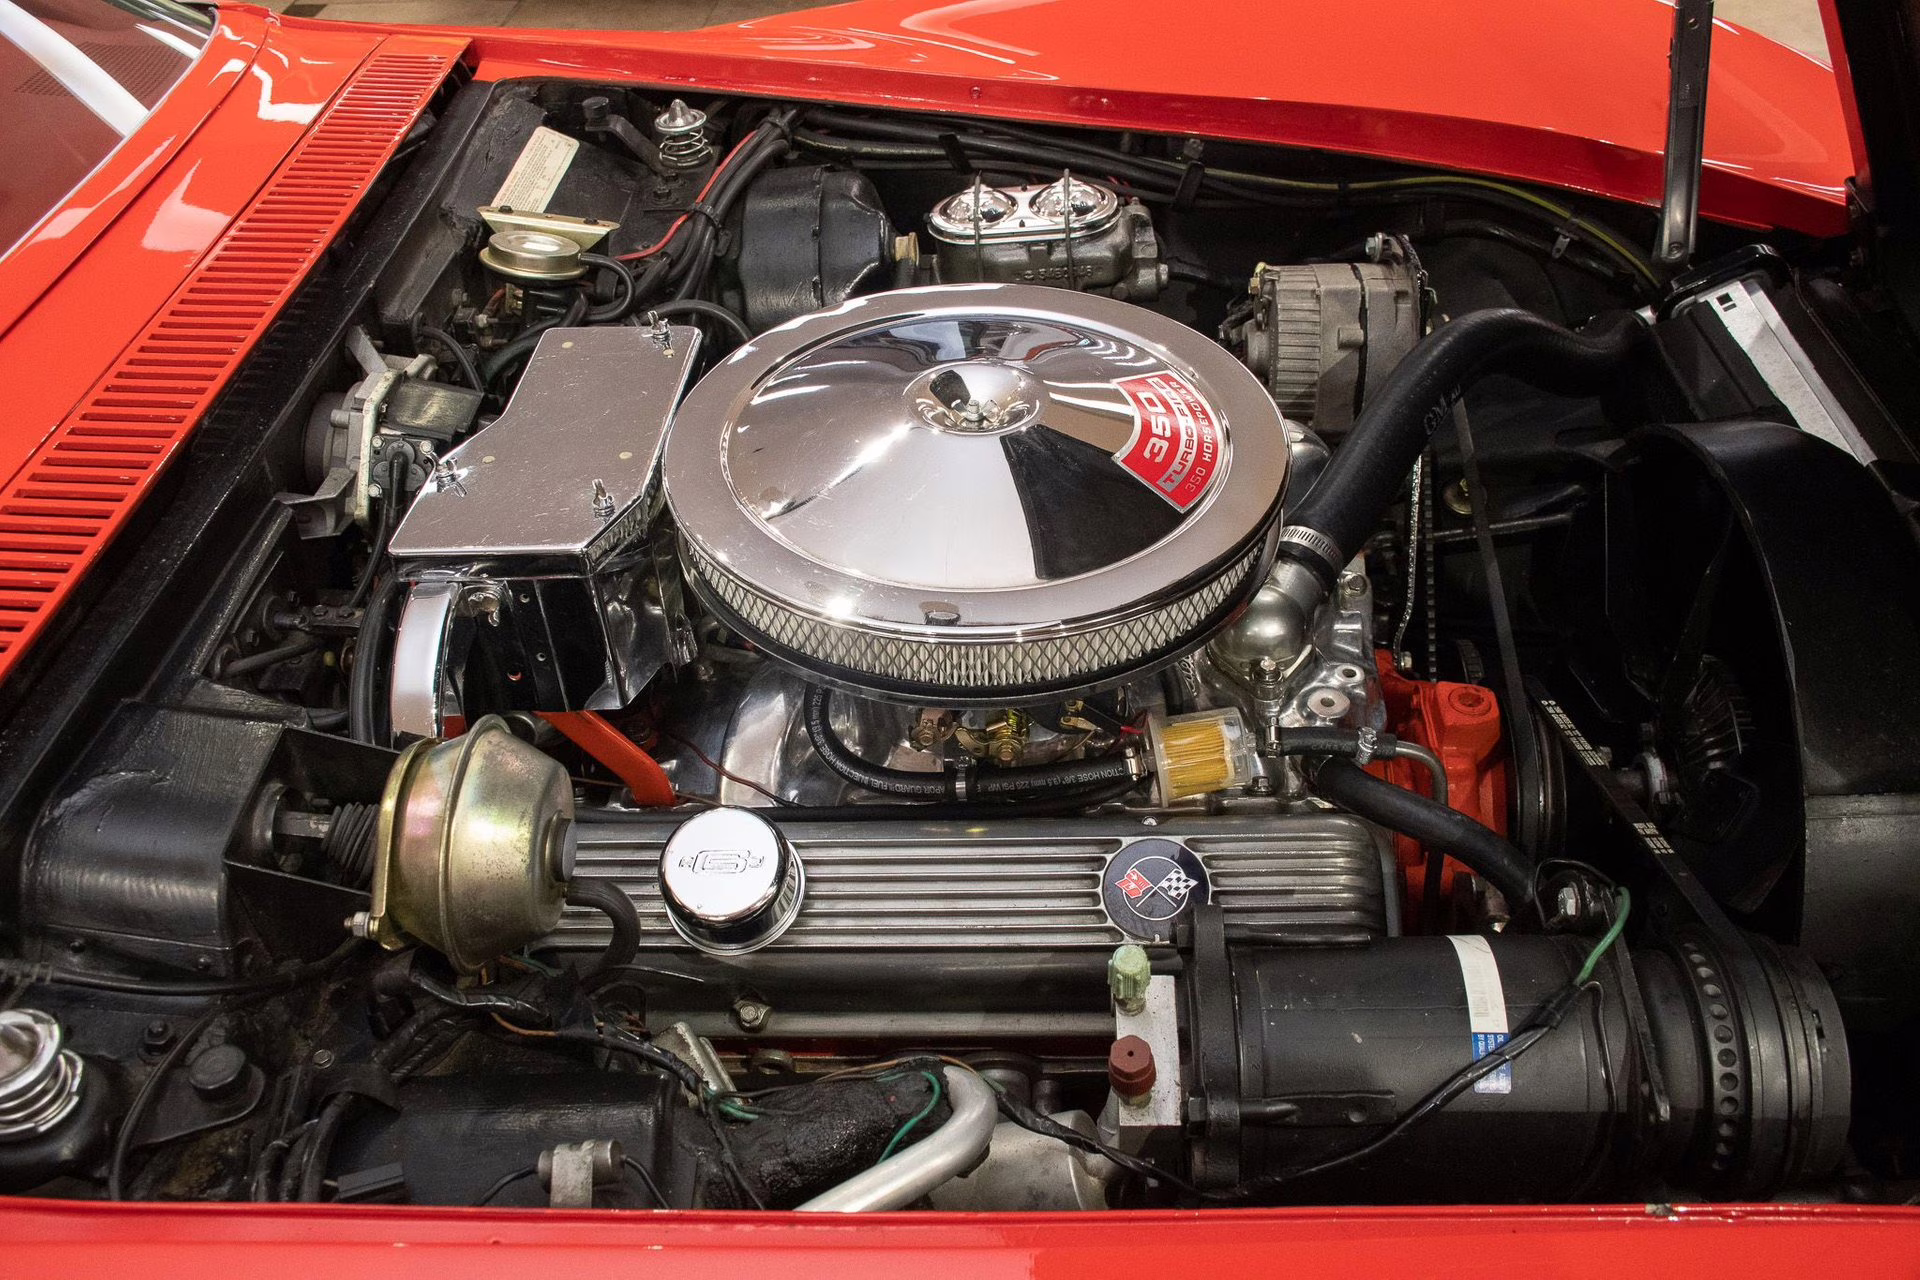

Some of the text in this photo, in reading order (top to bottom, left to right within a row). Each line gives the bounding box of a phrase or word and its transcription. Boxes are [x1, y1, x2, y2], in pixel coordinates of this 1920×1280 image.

[1136, 391, 1171, 463] 350
[1152, 379, 1195, 484] TURBO-FIRE
[1169, 381, 1213, 492] 350 HORSEPOWER
[836, 761, 869, 785] INJECTION
[1077, 772, 1100, 784] HOSE
[1100, 767, 1125, 779] CTION
[869, 777, 889, 790] FUEL
[923, 784, 945, 794] APOR
[1002, 781, 1016, 791] PSI
